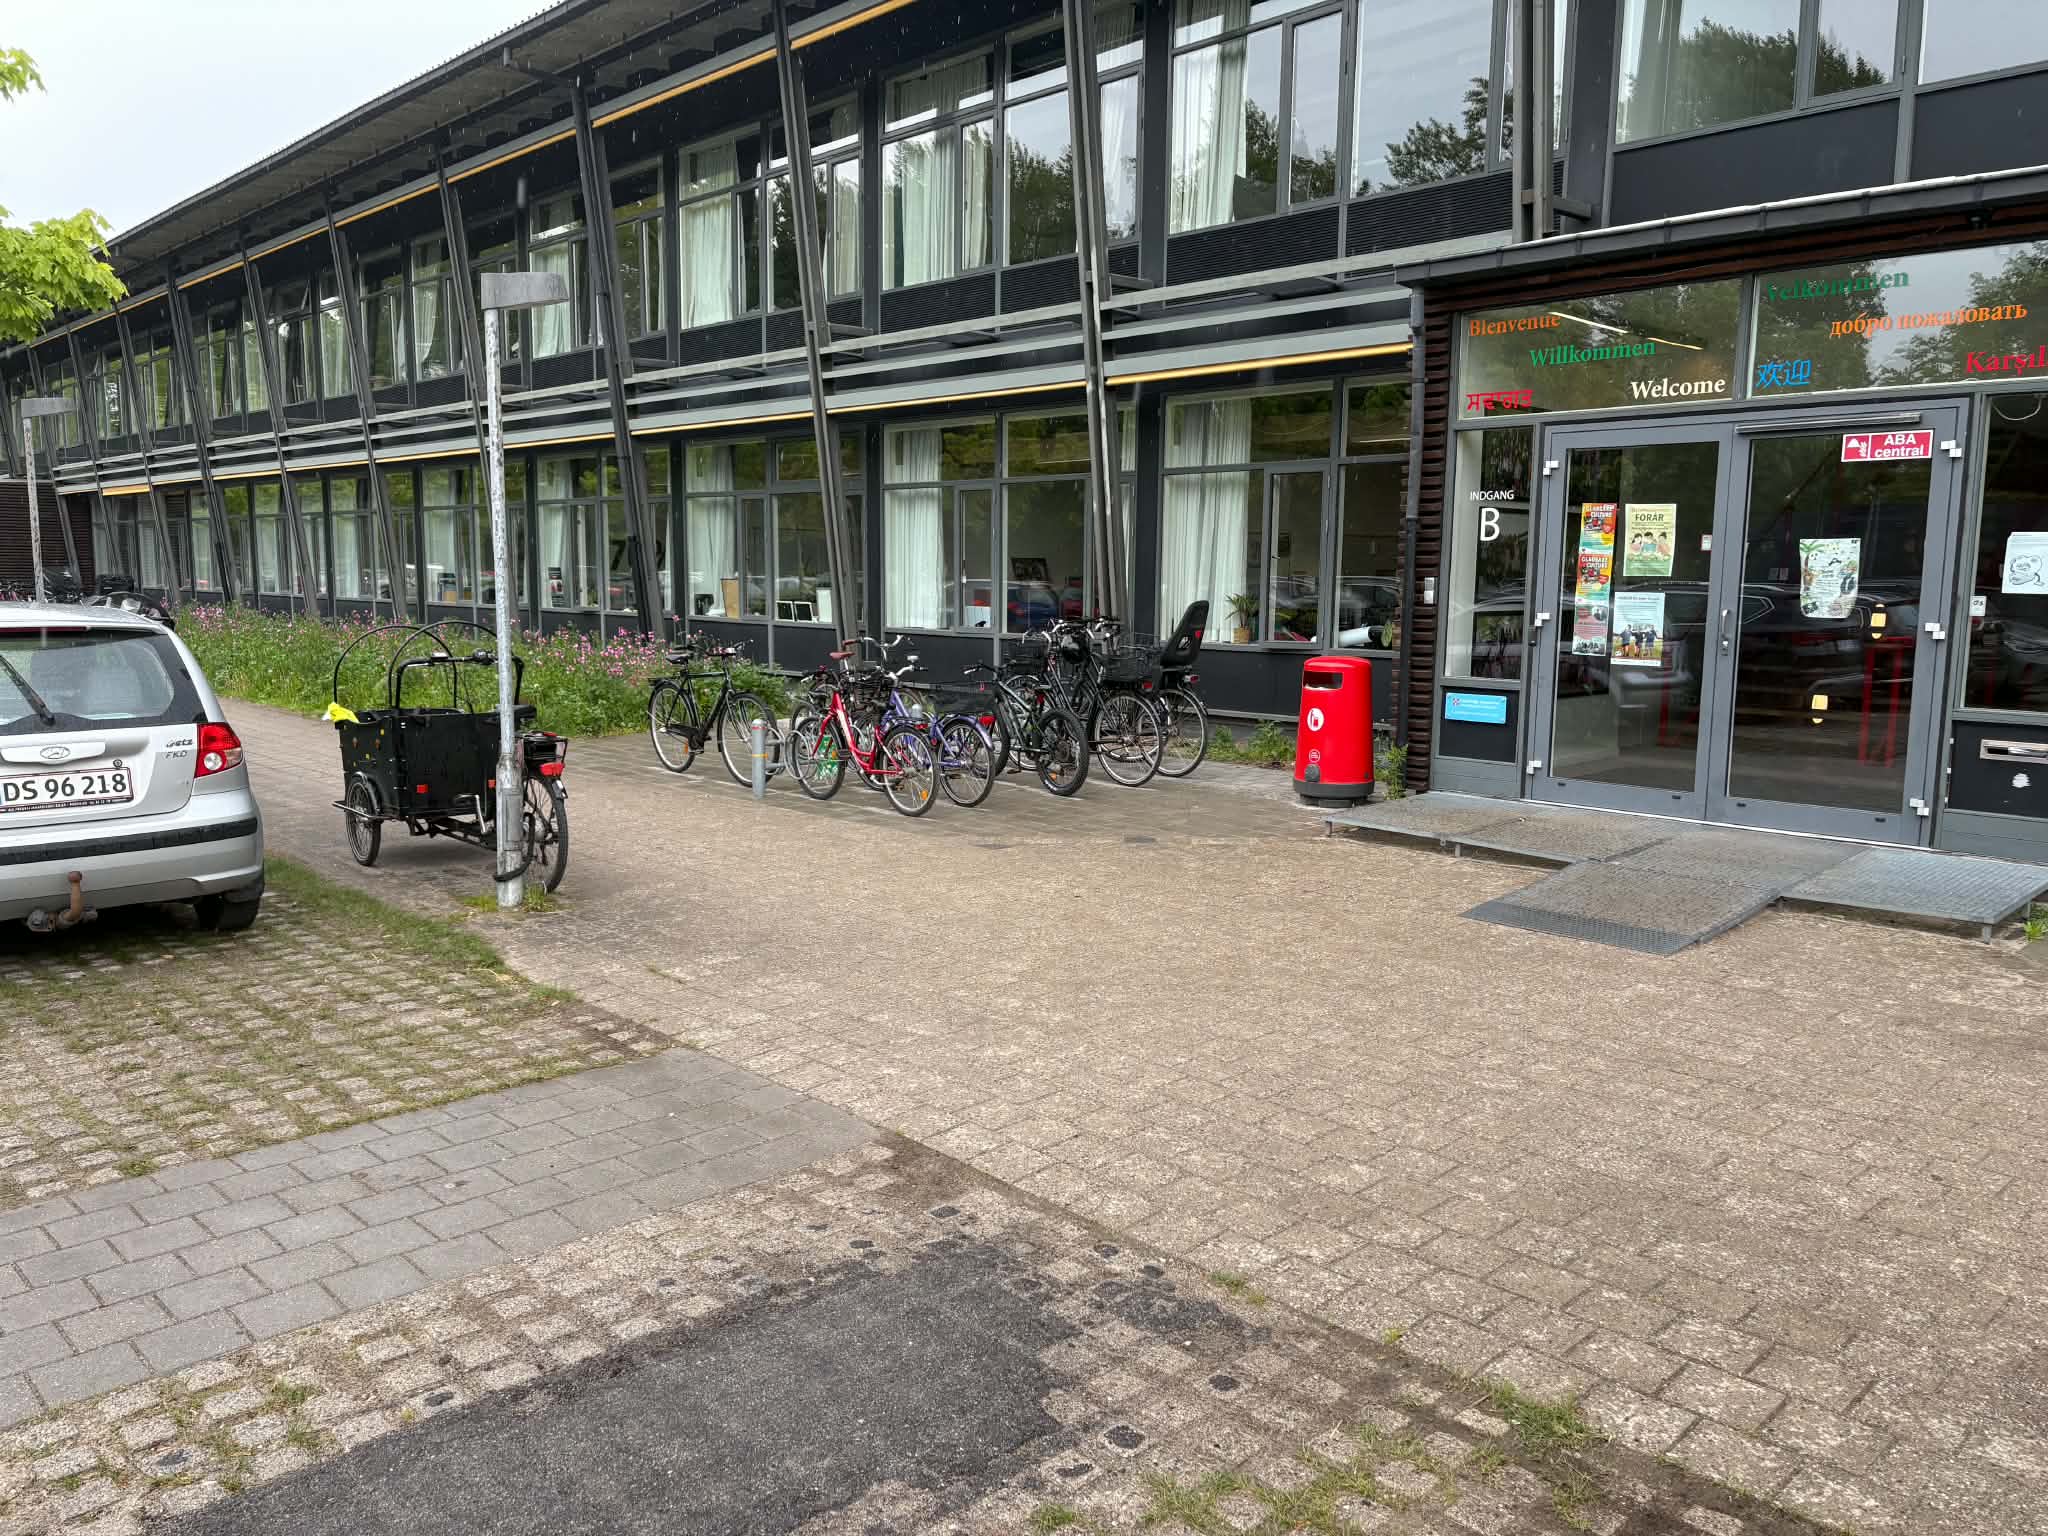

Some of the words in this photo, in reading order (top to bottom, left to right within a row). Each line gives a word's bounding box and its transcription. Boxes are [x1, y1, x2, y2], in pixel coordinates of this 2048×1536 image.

[1766, 271, 1910, 301] Velkommen
[1469, 316, 1561, 337] Bienvenue
[1830, 312, 1892, 339] добро
[1896, 303, 2028, 329] пожаловать
[1529, 342, 1657, 368] Willkommen
[1966, 345, 2048, 377] Karşıl
[1755, 358, 1812, 388] 欢迎
[1631, 377, 1726, 400] Welcome
[1874, 444, 1925, 458] central
[1883, 433, 1917, 446] ABA
[1470, 490, 1514, 501] INDGANG
[1480, 507, 1500, 542] B
[3, 780, 38, 802] DS
[44, 776, 75, 799] 96
[81, 773, 126, 795] 218
